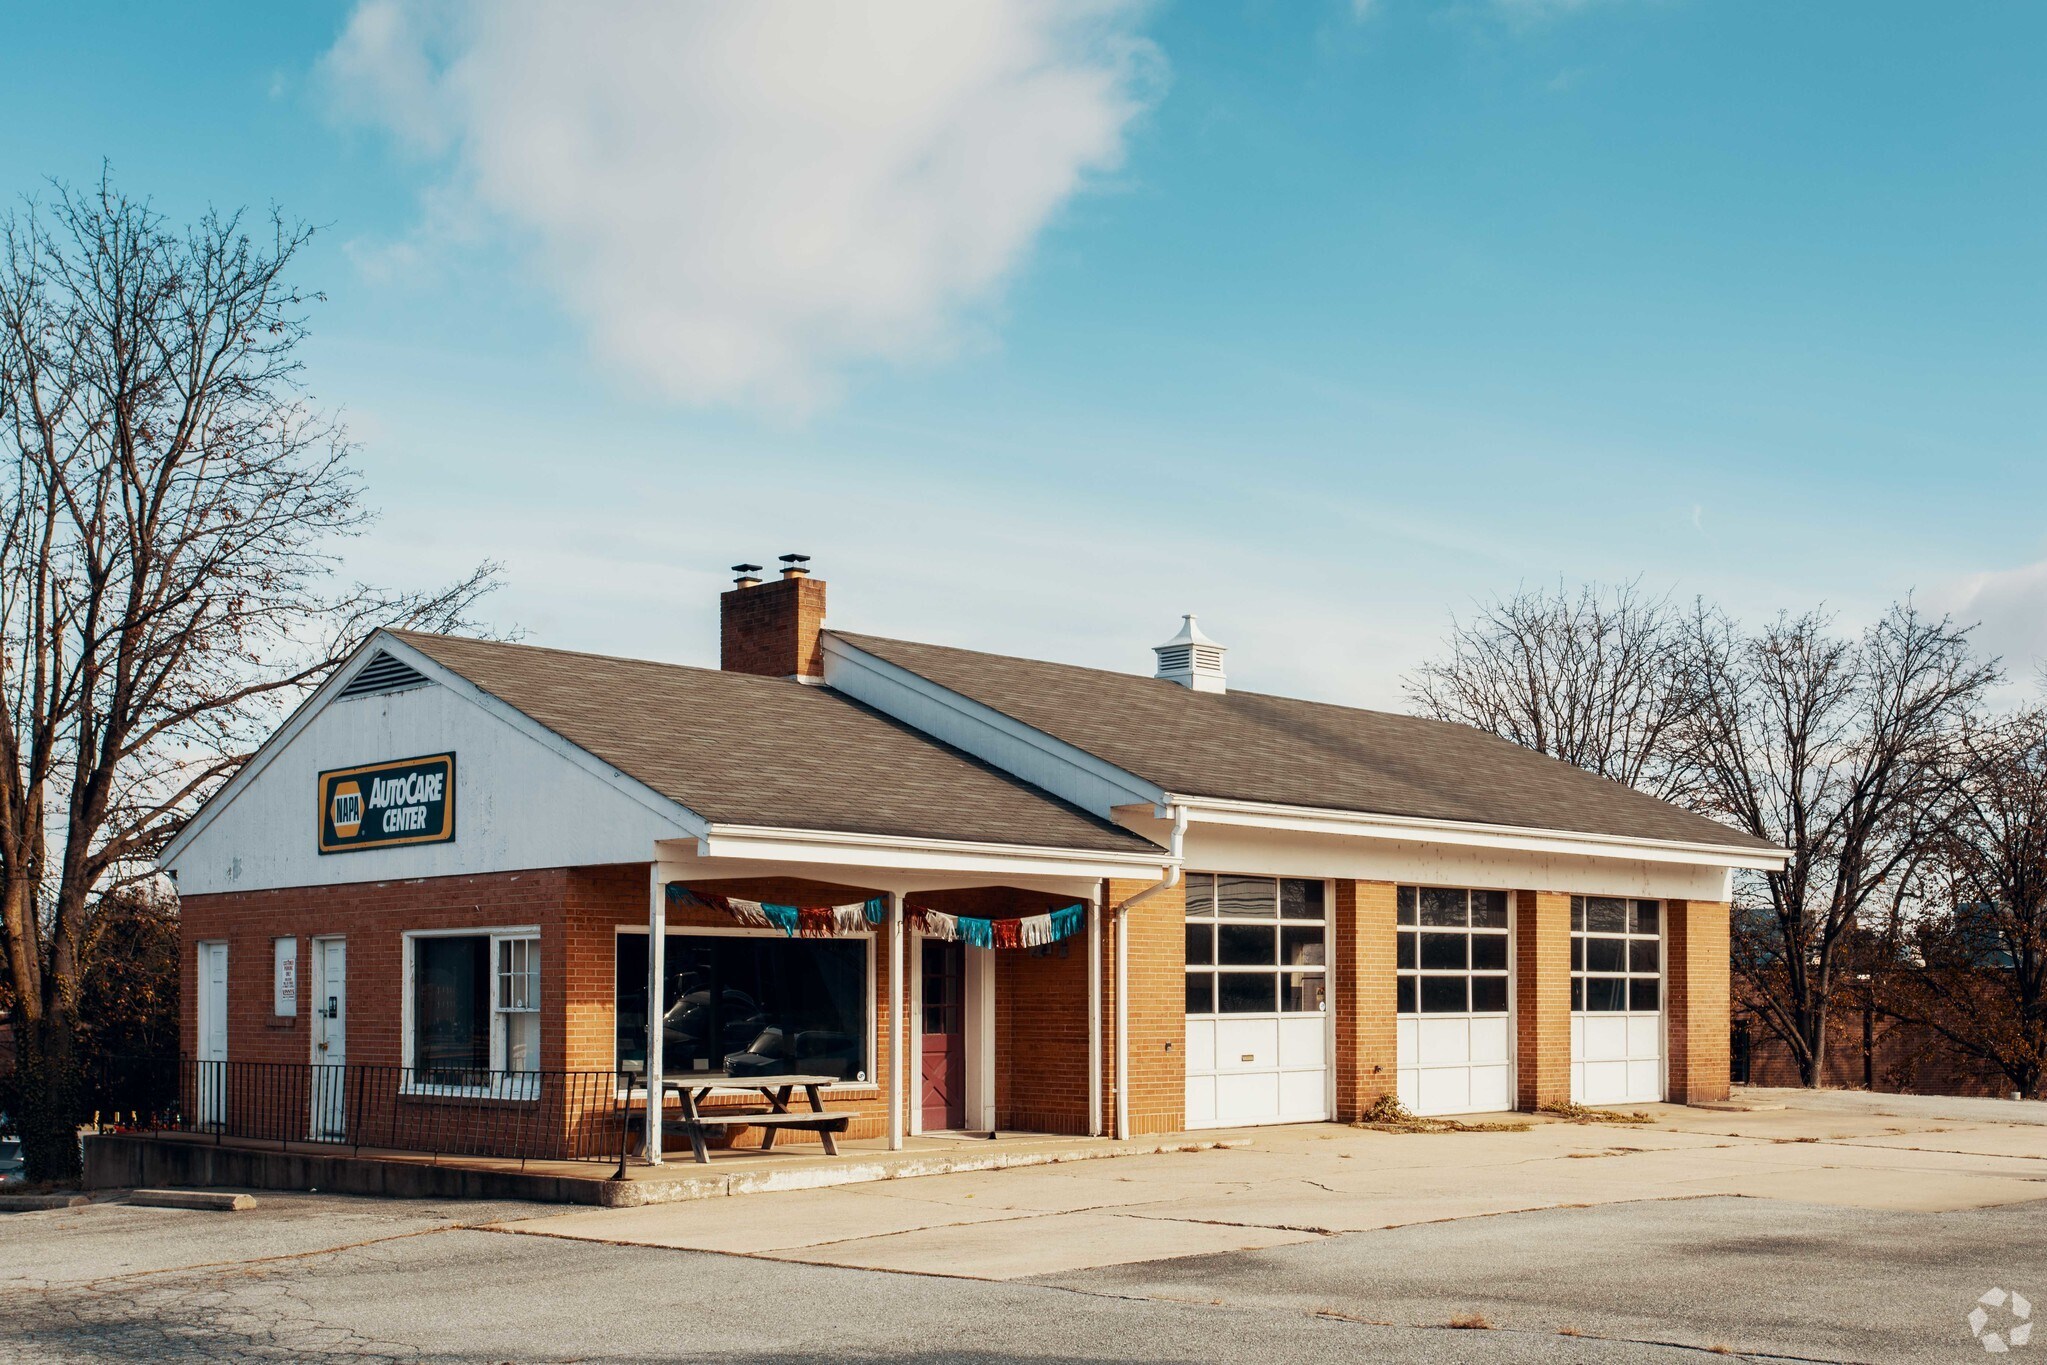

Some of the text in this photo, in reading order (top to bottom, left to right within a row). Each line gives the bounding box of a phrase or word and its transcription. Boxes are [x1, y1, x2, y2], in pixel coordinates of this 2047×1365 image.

[369, 772, 444, 809] AUTOCARE
[336, 795, 360, 823] NAPA
[382, 805, 428, 833] CENTER
